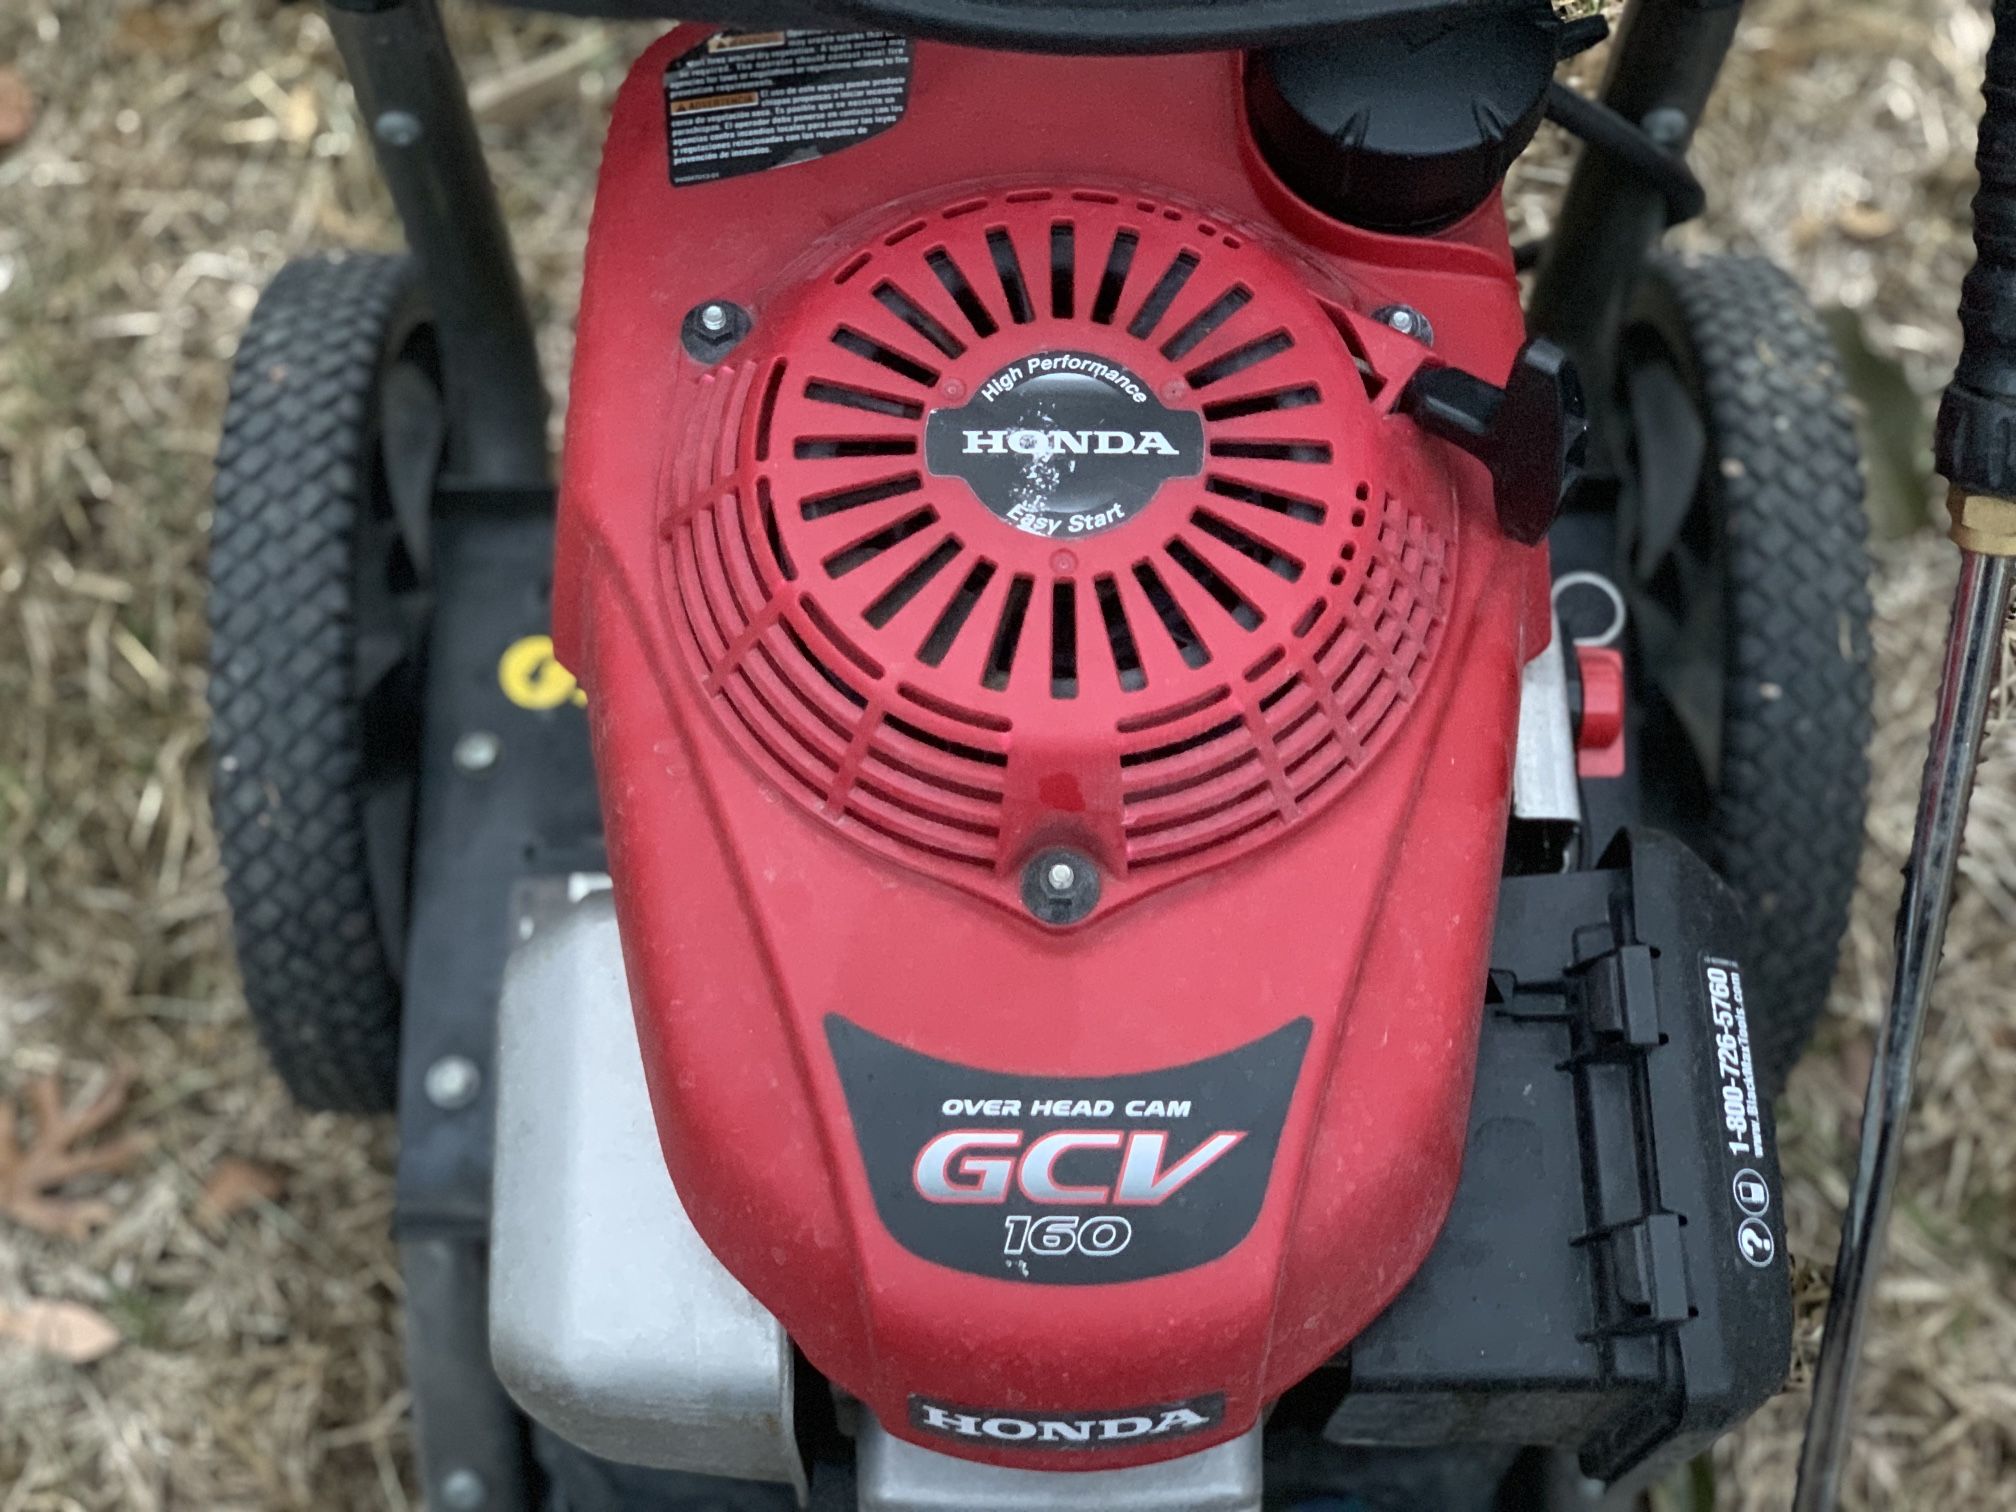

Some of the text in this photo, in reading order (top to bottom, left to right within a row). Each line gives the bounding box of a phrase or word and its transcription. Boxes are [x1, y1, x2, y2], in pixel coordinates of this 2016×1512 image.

[980, 354, 1147, 404] High Performance
[962, 430, 1180, 455] HONDA
[1006, 502, 1126, 536] Easy Start
[1706, 967, 1751, 1156] 1-800-726-5760
[1730, 971, 1764, 1159] www.BlackMaxTools.com
[942, 1099, 1191, 1117] OVER HEAD CAM
[913, 1128, 1248, 1207] GCV
[1003, 1215, 1132, 1256] 160
[922, 1405, 1210, 1441] HONDA
